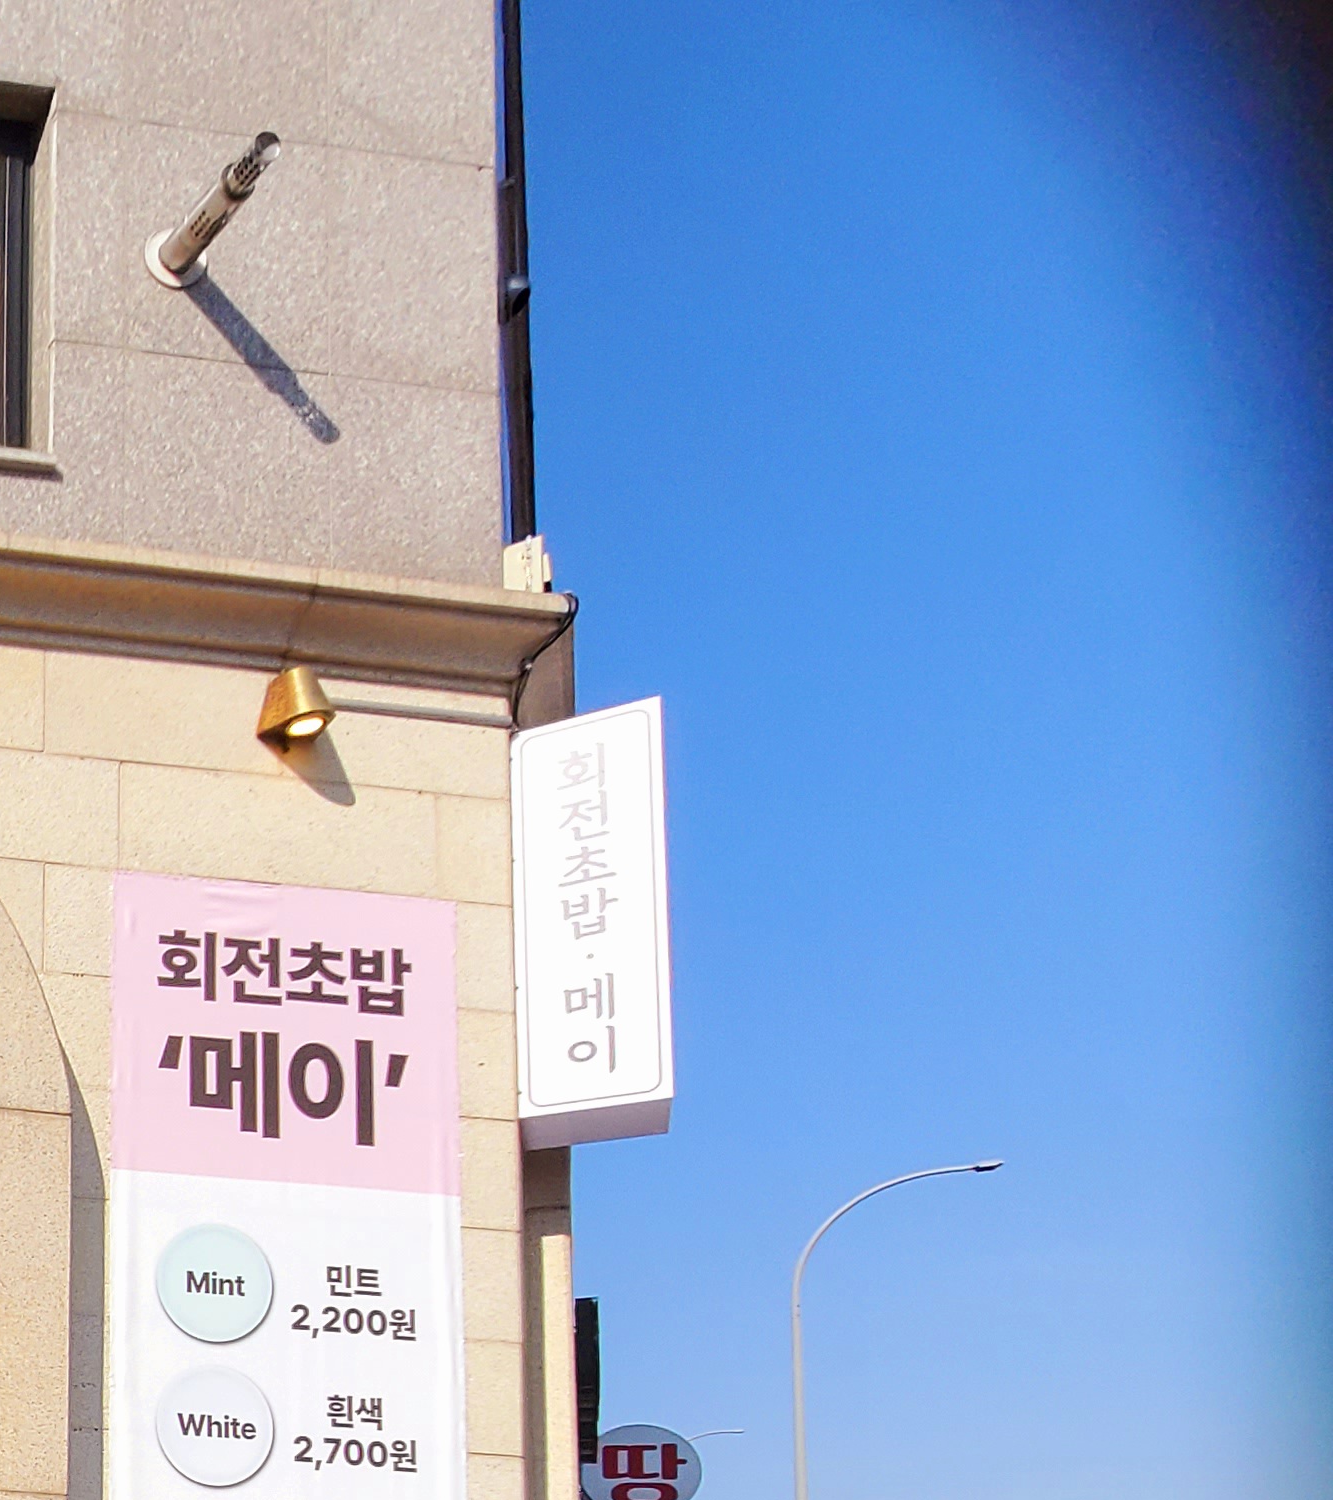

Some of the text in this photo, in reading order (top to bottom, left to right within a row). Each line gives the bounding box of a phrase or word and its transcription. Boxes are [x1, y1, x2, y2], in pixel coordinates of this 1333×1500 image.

[555, 742, 619, 1074] 회전초밥 메이
[156, 929, 413, 1018] 회전초밥
[185, 1270, 246, 1298] Mint
[326, 1264, 383, 1298] 민트
[290, 1303, 418, 1342] 2,200원
[177, 1412, 257, 1440] White
[325, 1394, 384, 1431] 흰색
[292, 1435, 419, 1474] 2,700원
